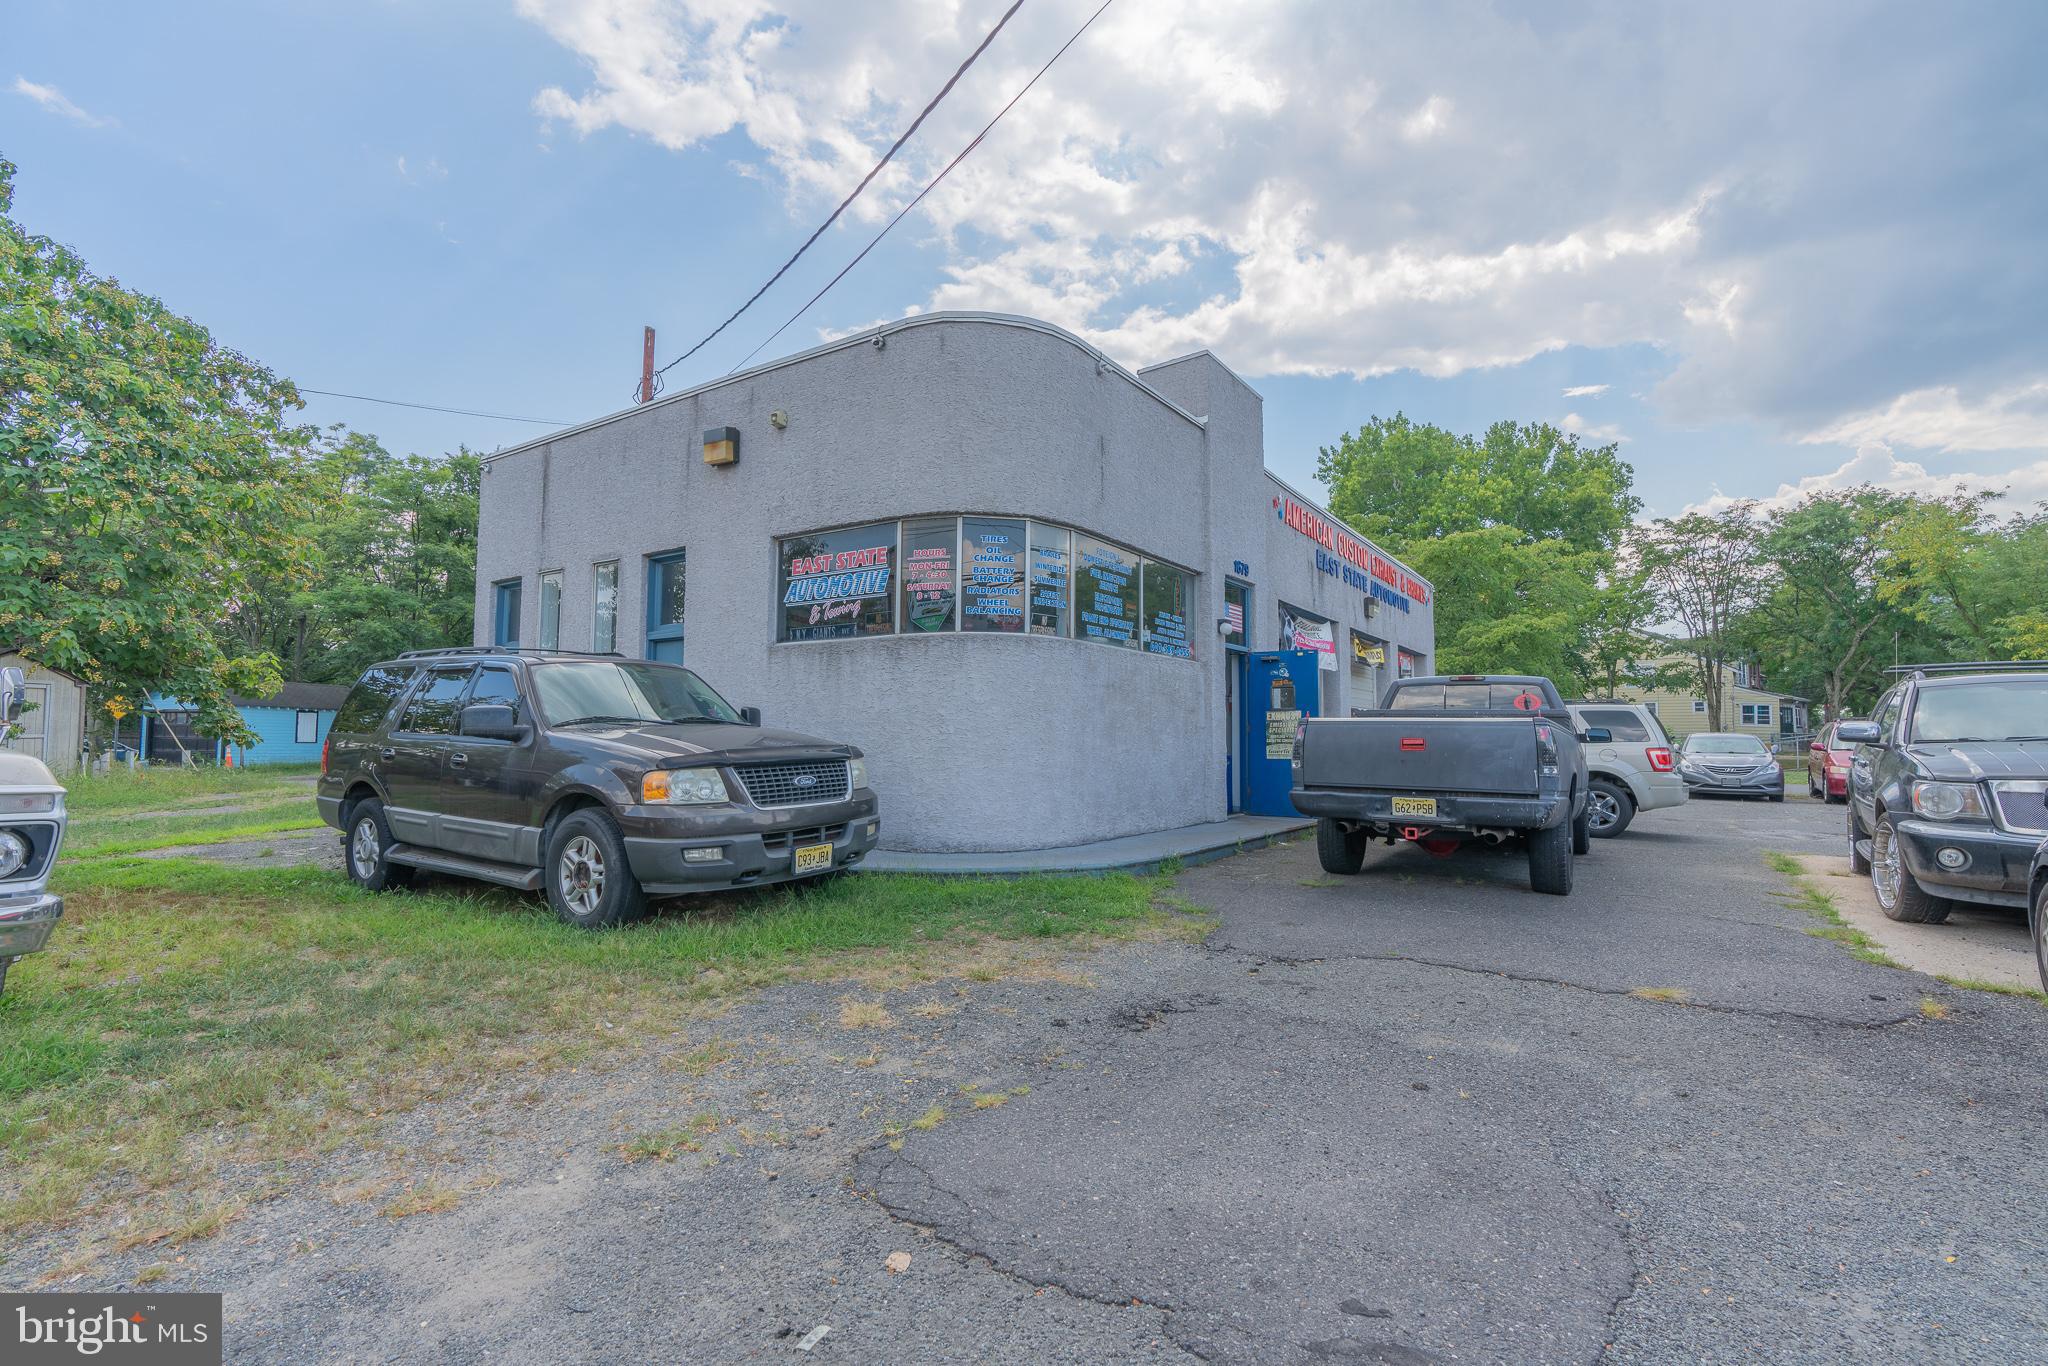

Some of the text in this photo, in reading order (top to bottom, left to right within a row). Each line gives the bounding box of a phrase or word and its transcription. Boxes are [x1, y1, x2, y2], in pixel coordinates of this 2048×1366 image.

[981, 535, 1008, 544] TIRES
[1285, 499, 1333, 551] AMERICAN
[1337, 532, 1368, 571] CUSTOM
[1371, 554, 1397, 588] EXHAUST
[913, 548, 947, 557] HOURS
[985, 546, 1002, 554] OIL
[792, 546, 888, 576] EAST STATE
[973, 554, 1015, 563] CHANGE
[909, 561, 949, 571] MON-FRI
[972, 567, 1015, 575] BATTERY
[972, 575, 1014, 583] CHANGE
[1316, 549, 1409, 614] EAST STATE AUTOMOTIVE
[783, 568, 891, 603] AUTOMOTIVE
[907, 582, 953, 591] SATURDAY
[967, 586, 1020, 595] RADIATORS
[977, 598, 1009, 606] WHEEL
[809, 600, 861, 624] & Towing
[965, 606, 1022, 615] BALANCING
[812, 627, 836, 639] GIANTS
